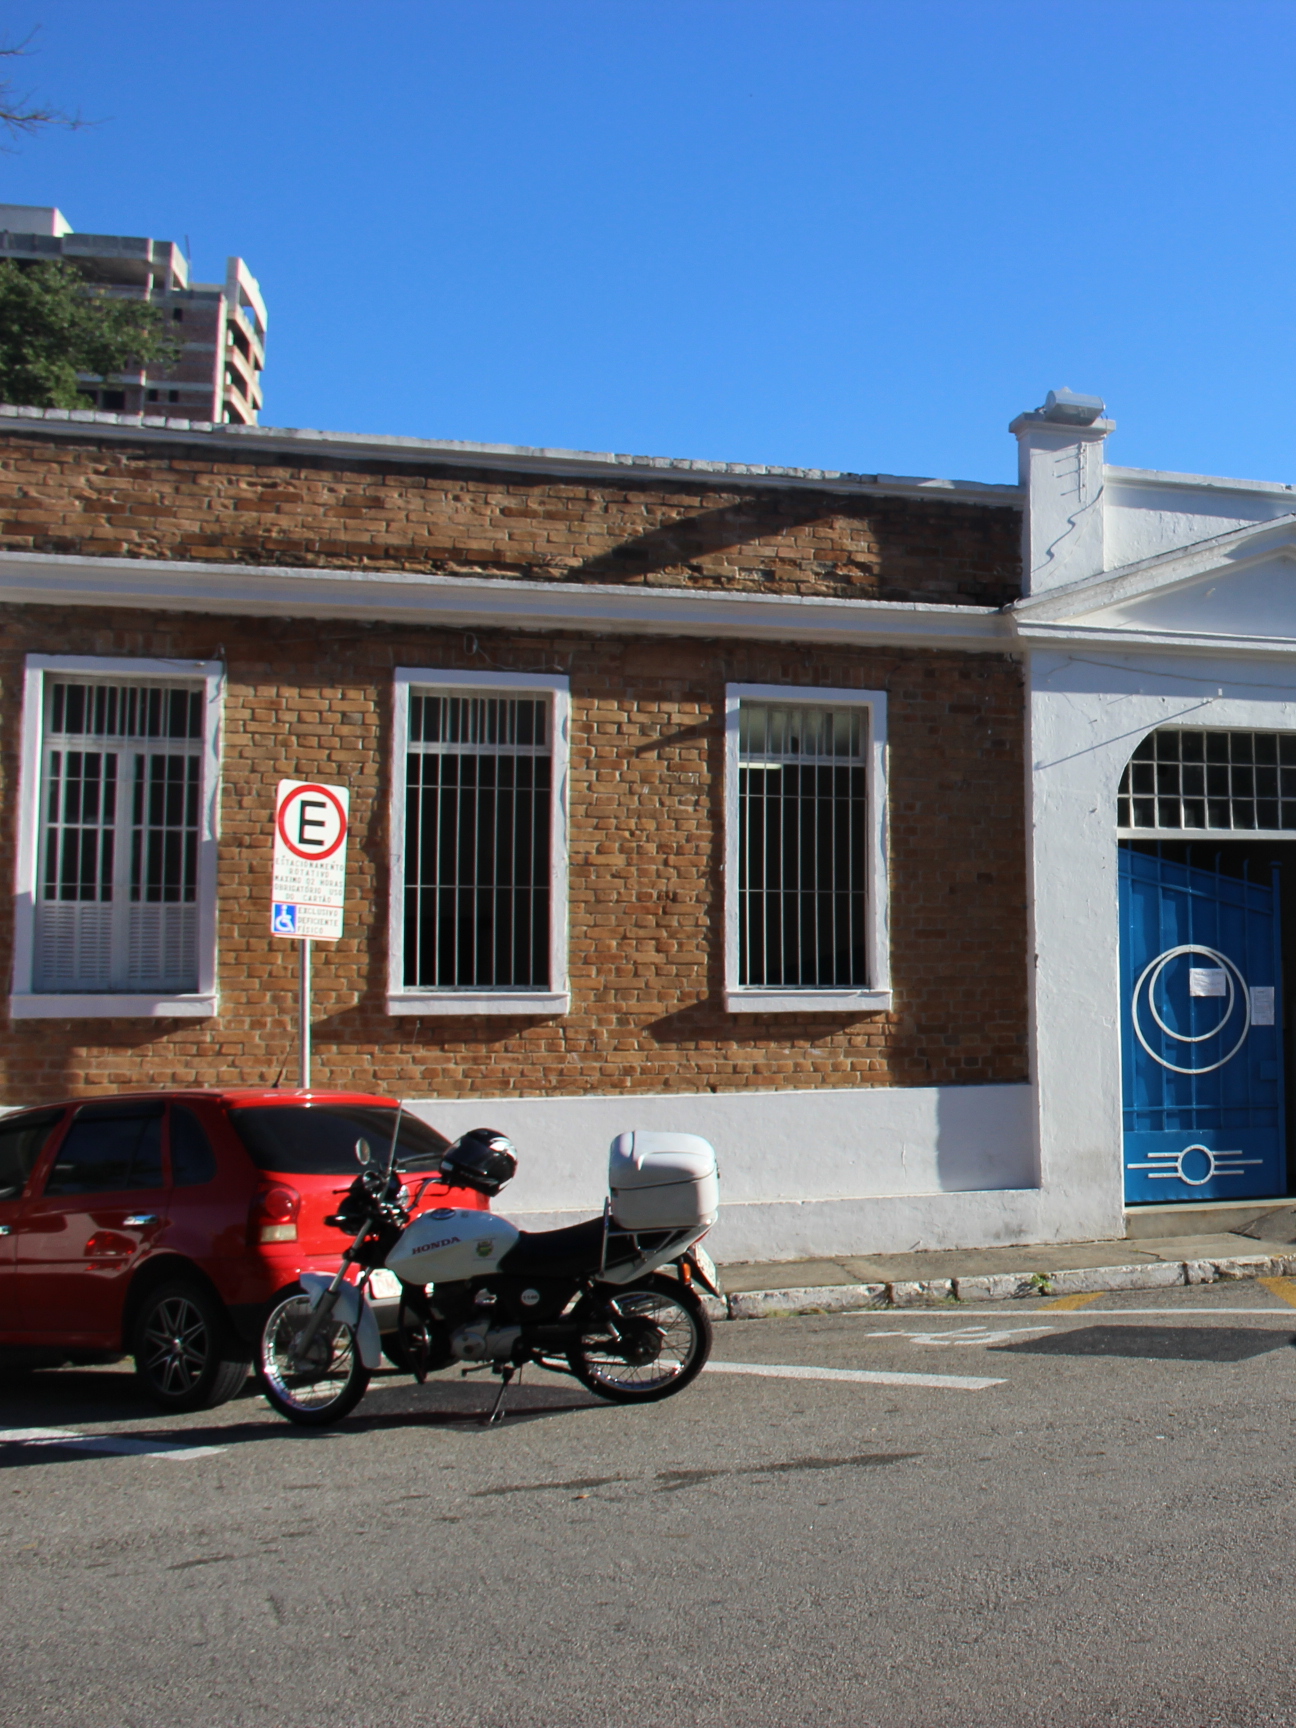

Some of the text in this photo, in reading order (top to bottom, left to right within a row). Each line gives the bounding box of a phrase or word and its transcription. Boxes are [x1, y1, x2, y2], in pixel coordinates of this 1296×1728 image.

[298, 799, 327, 846] E
[275, 857, 345, 871] ESTACIONAMENTO
[289, 867, 330, 878] ROTATIVO
[306, 877, 315, 886] 02
[320, 879, 344, 888] HORAS
[285, 892, 295, 900] DO
[329, 888, 343, 896] USO
[298, 906, 339, 917] EXCLUSIVO
[297, 916, 339, 927] DEFICIENTE
[411, 1236, 462, 1255] HONDA
